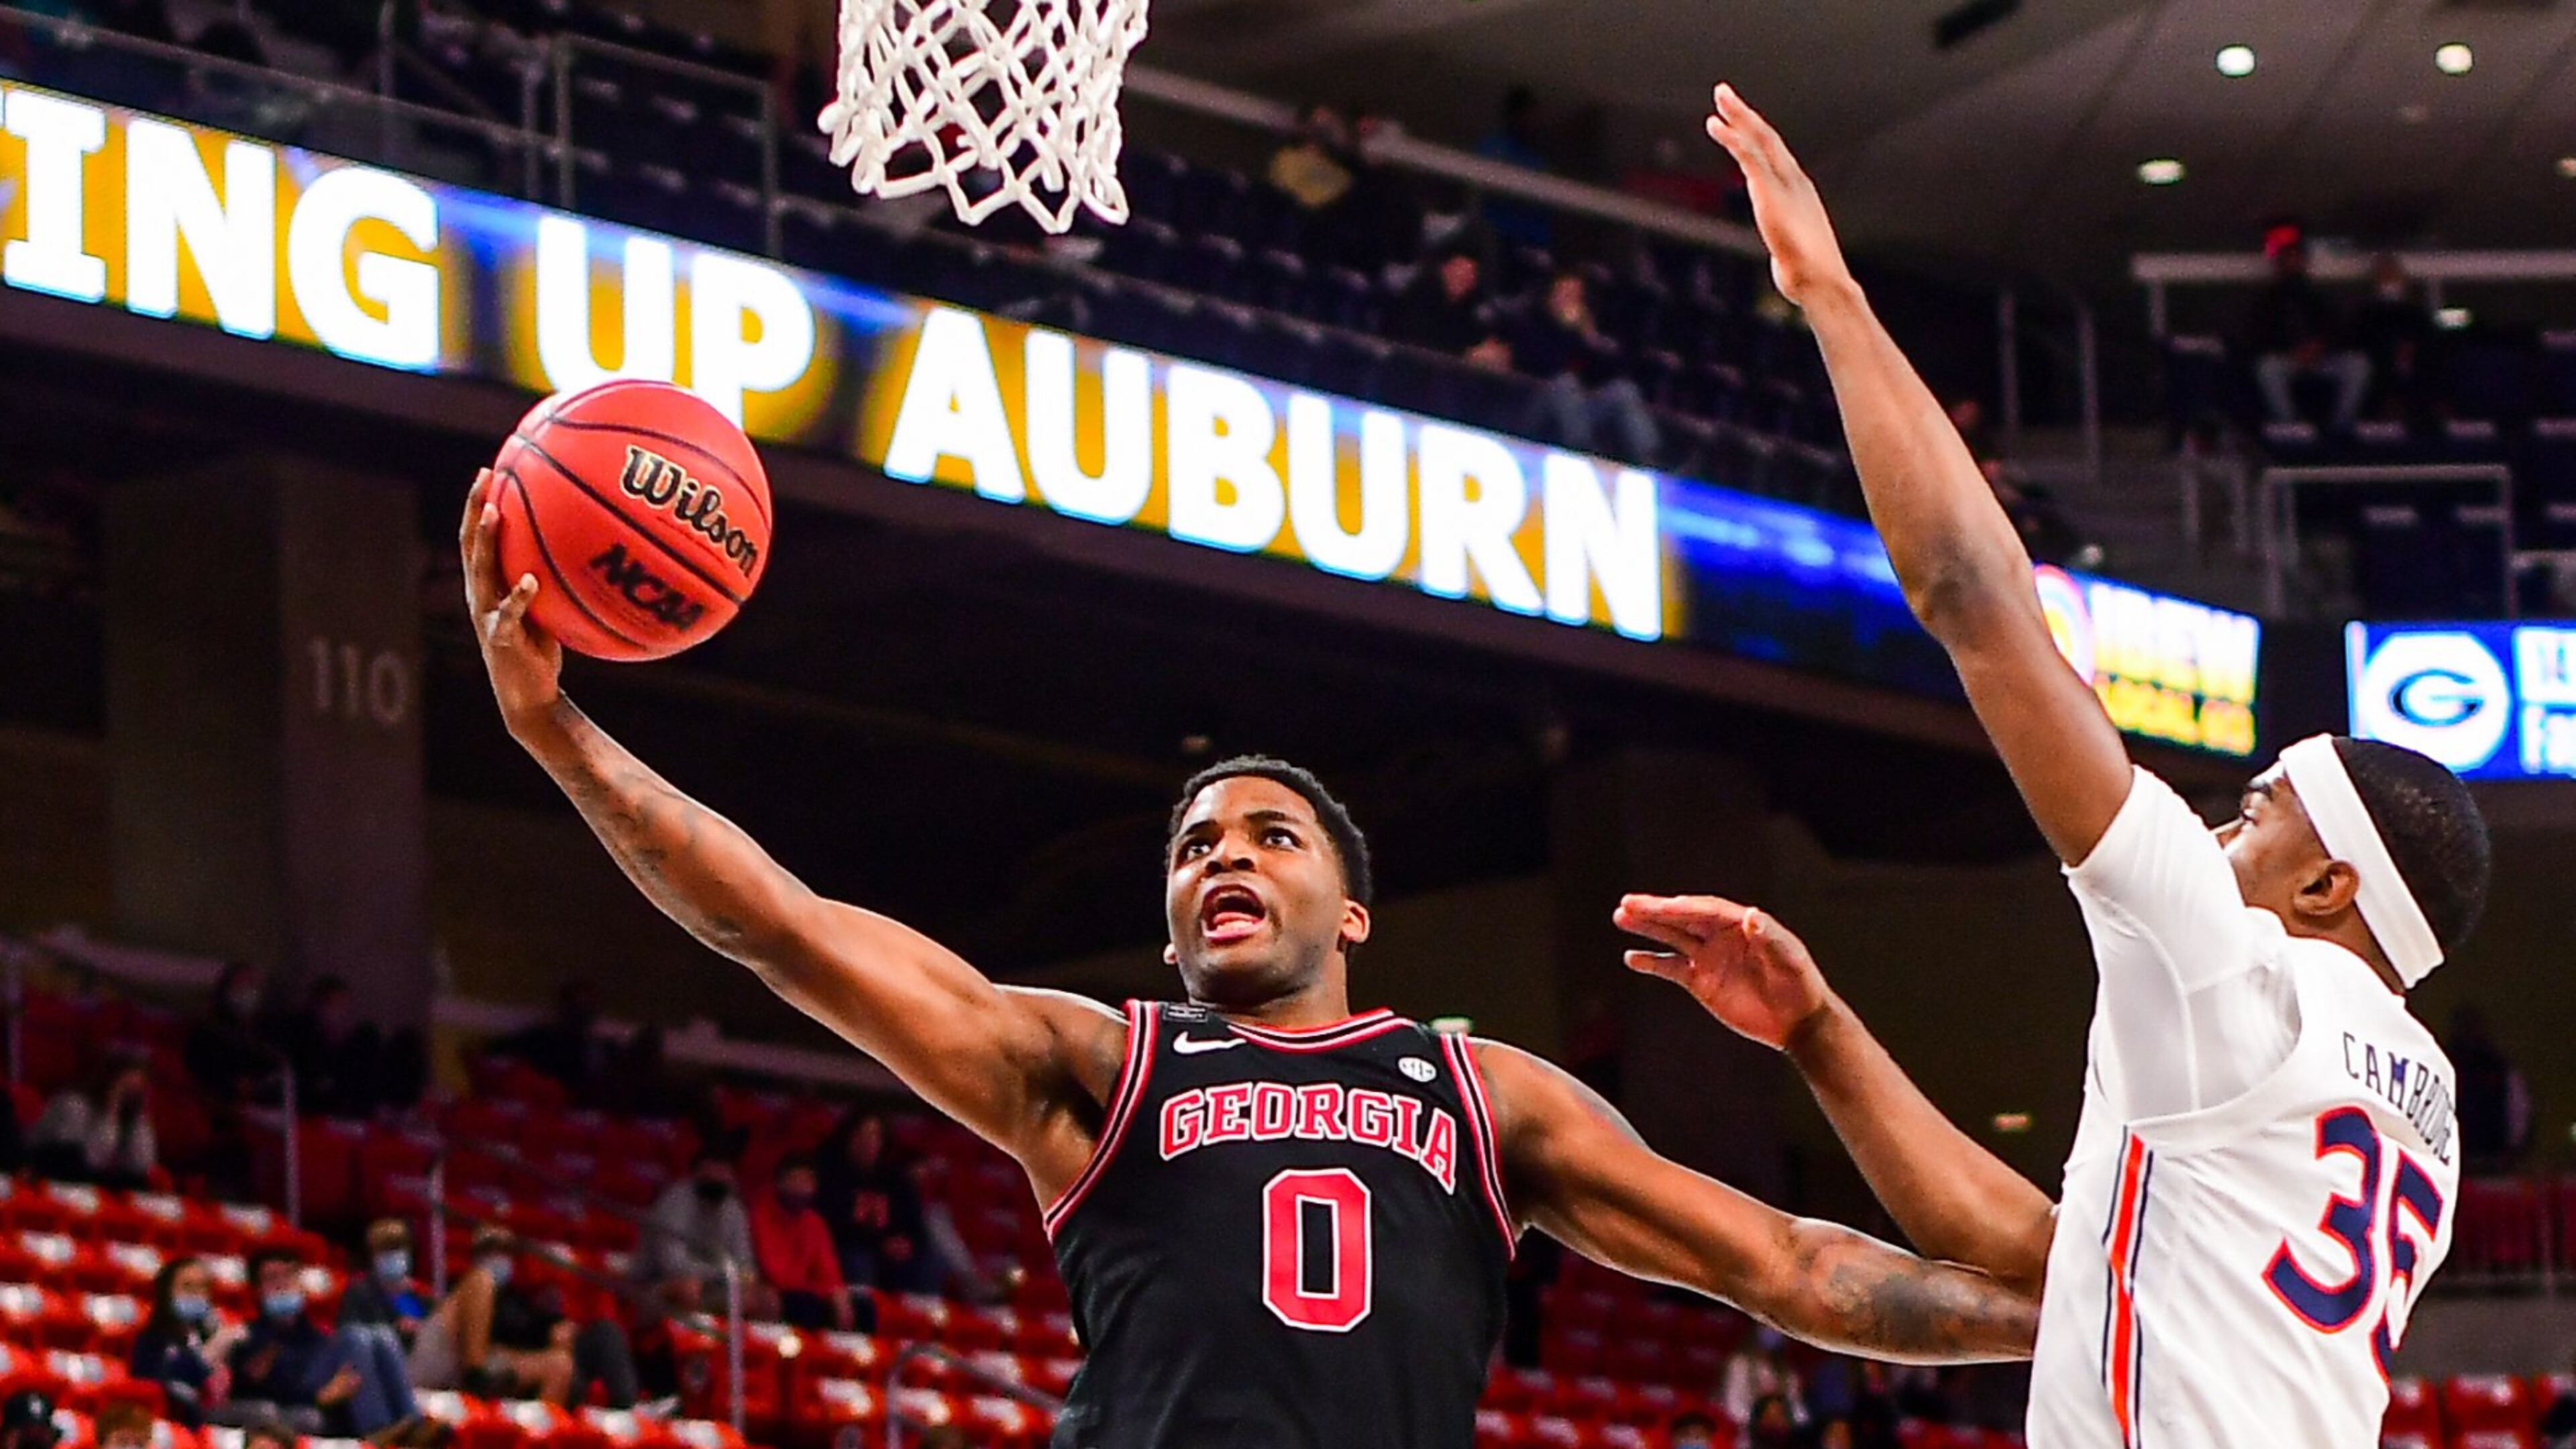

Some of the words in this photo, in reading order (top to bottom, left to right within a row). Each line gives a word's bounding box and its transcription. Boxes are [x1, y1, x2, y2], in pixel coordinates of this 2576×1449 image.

[0, 87, 439, 374] ING
[536, 215, 816, 436] UP
[883, 305, 1662, 643] AUBURN
[619, 443, 759, 580] Wilson
[307, 638, 408, 726] 110
[1160, 1082, 1457, 1195] GEORGIA
[1263, 1167, 1372, 1333] 0
[2261, 1106, 2444, 1387] 35
